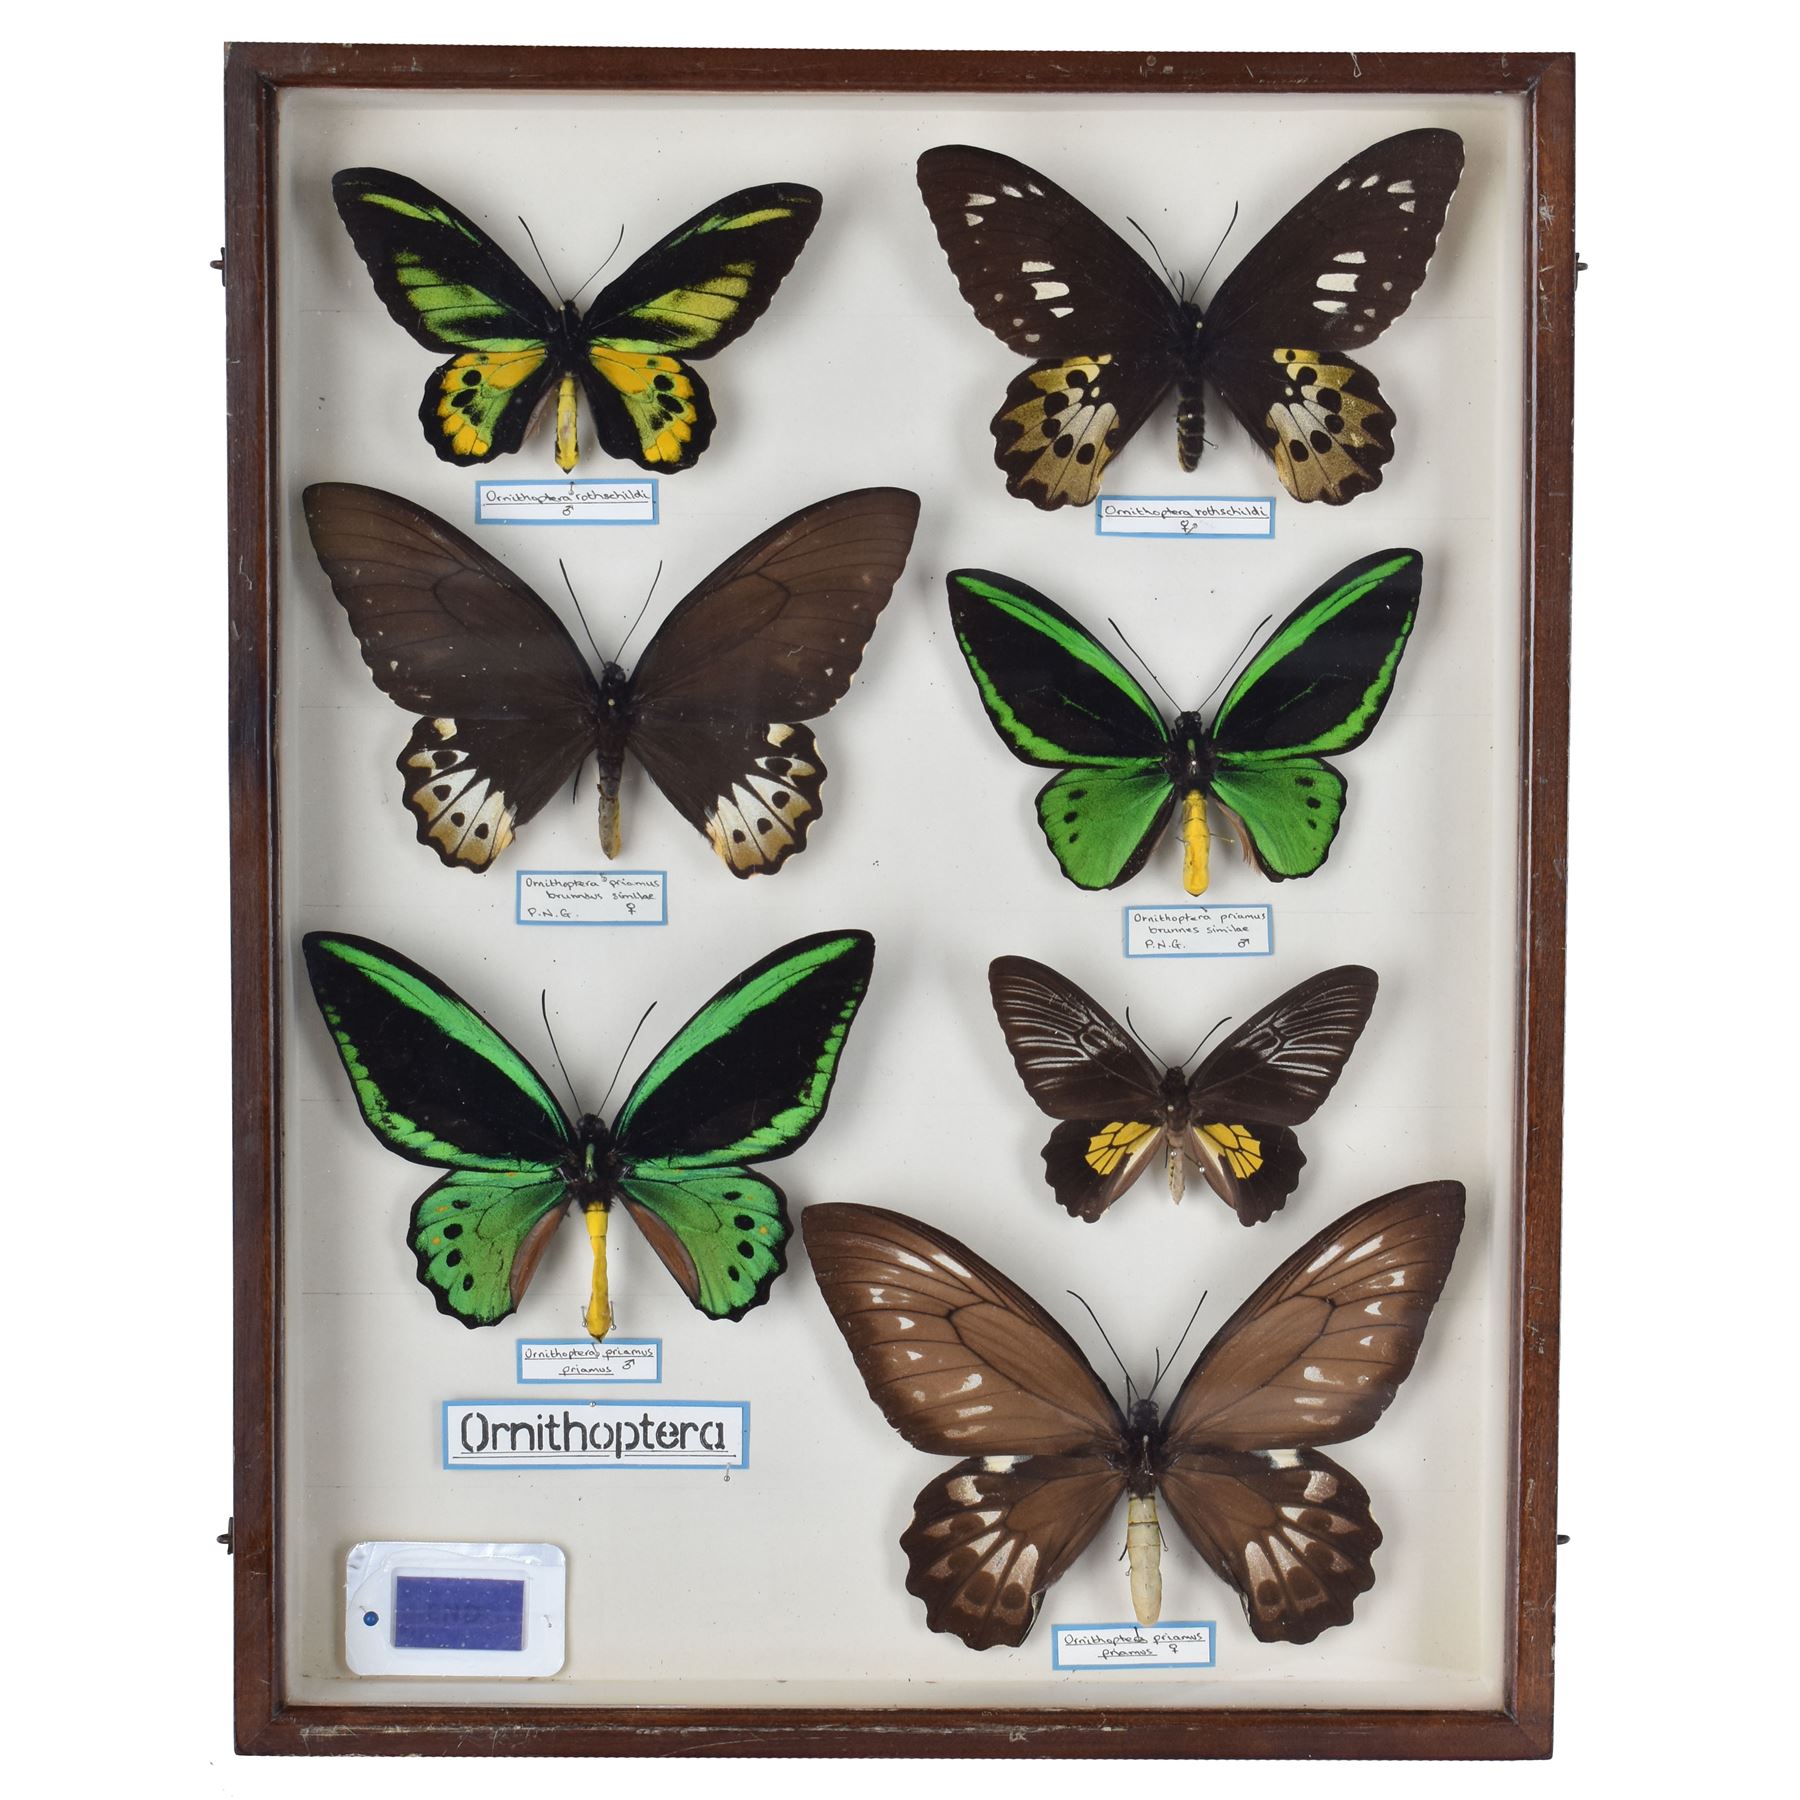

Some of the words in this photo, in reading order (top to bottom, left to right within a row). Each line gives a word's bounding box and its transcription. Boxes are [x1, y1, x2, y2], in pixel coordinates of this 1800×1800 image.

[576, 489, 650, 501] rothschildi
[1105, 505, 1192, 519] Ornithoptera
[1197, 505, 1269, 516] rothschildi
[525, 877, 599, 890] Ornithoptera
[608, 878, 660, 889] priamus
[527, 907, 580, 918] P.N.G.
[1134, 913, 1210, 924] Ornithoptera
[1220, 912, 1266, 924] priamus
[1145, 939, 1186, 949] P.N.G.
[525, 1347, 597, 1360] Ornithoptera
[605, 1347, 654, 1360] priamus
[562, 1364, 612, 1376] priamus
[461, 1411, 726, 1459] Ornithoptera
[1153, 1632, 1203, 1645] priamus
[1102, 1648, 1154, 1660] priamus
